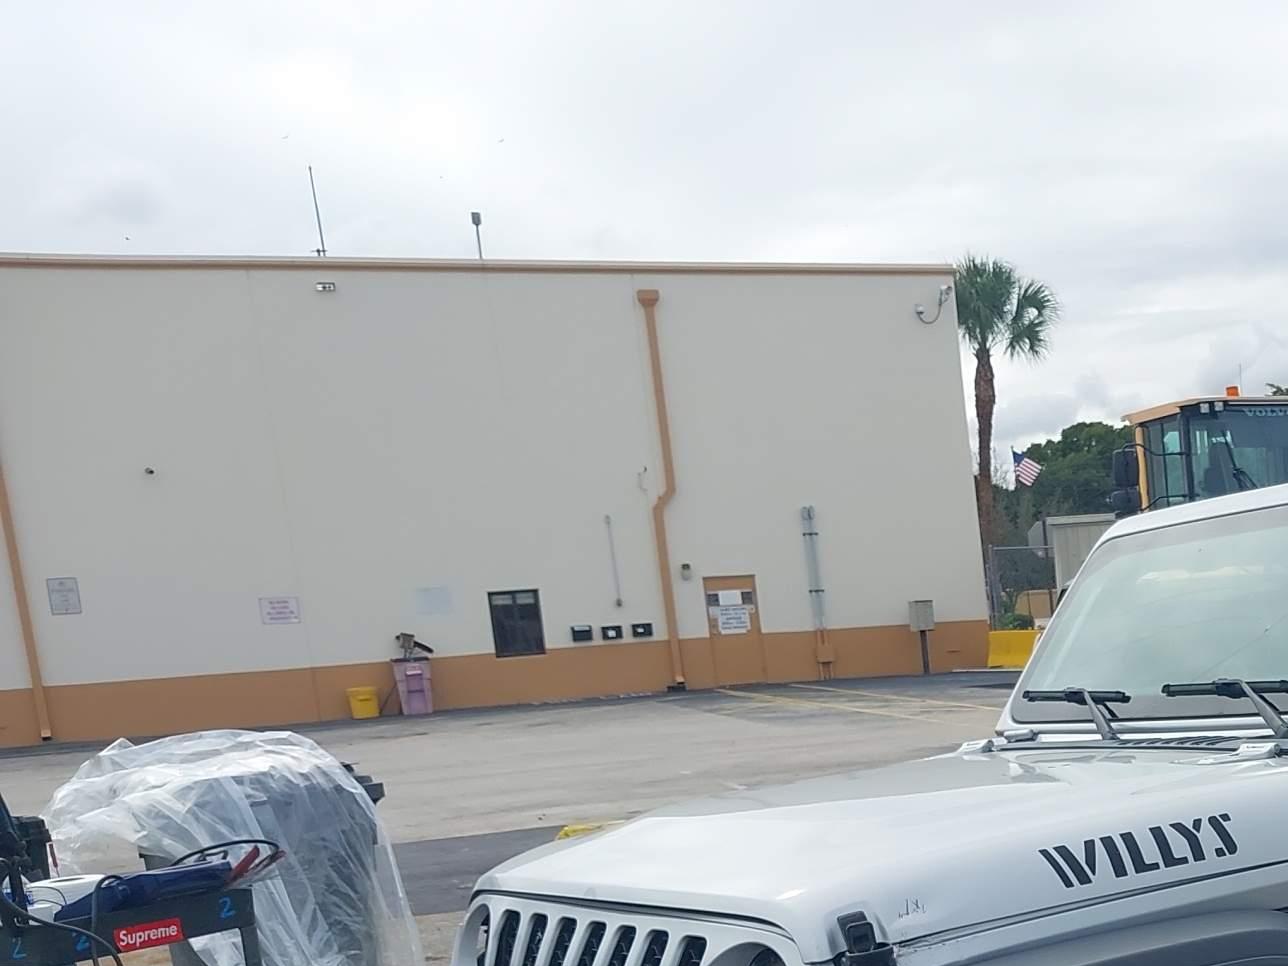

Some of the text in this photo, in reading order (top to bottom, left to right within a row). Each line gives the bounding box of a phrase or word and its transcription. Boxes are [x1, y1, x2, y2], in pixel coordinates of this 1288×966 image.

[1038, 812, 1239, 889] WILLYS
[219, 897, 236, 919] 2
[119, 923, 178, 947] Supreme
[10, 937, 27, 961] 2
